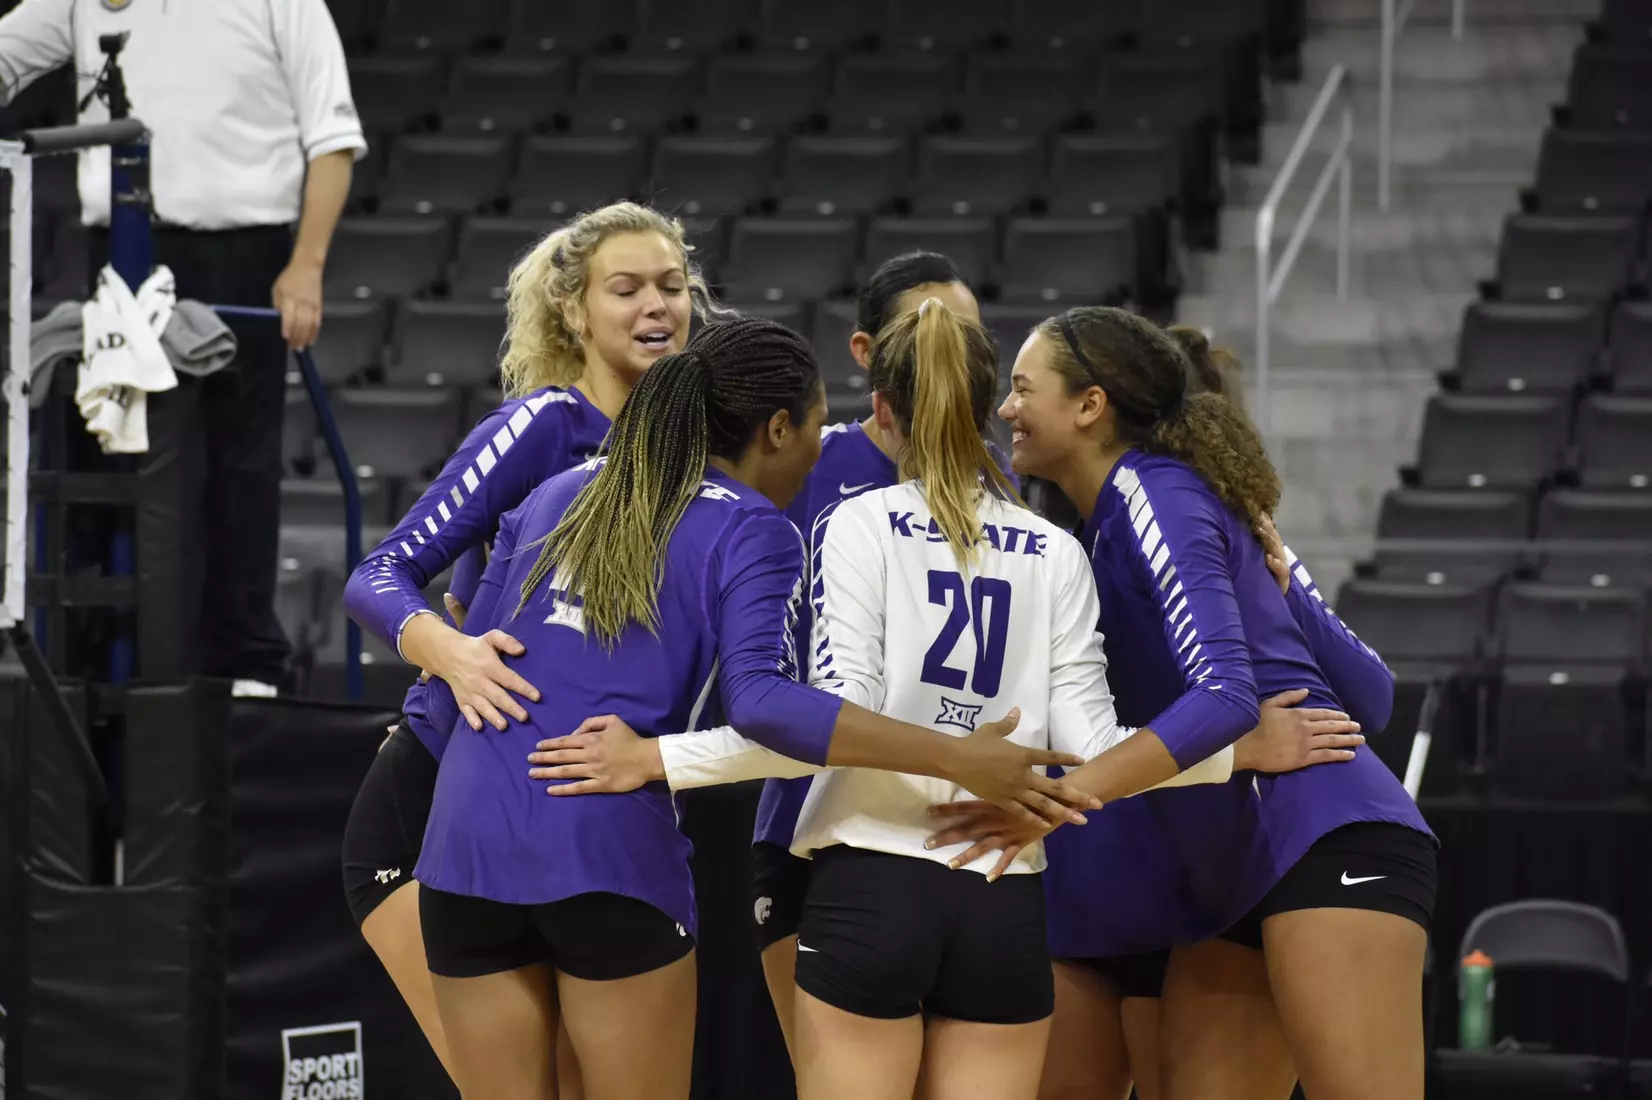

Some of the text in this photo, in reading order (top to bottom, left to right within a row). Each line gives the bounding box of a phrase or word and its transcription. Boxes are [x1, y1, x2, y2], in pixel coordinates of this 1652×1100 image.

[920, 569, 1012, 699] 20
[934, 696, 983, 732] XII
[288, 1052, 358, 1084] SPORT
[286, 1078, 360, 1100] FLOORS
